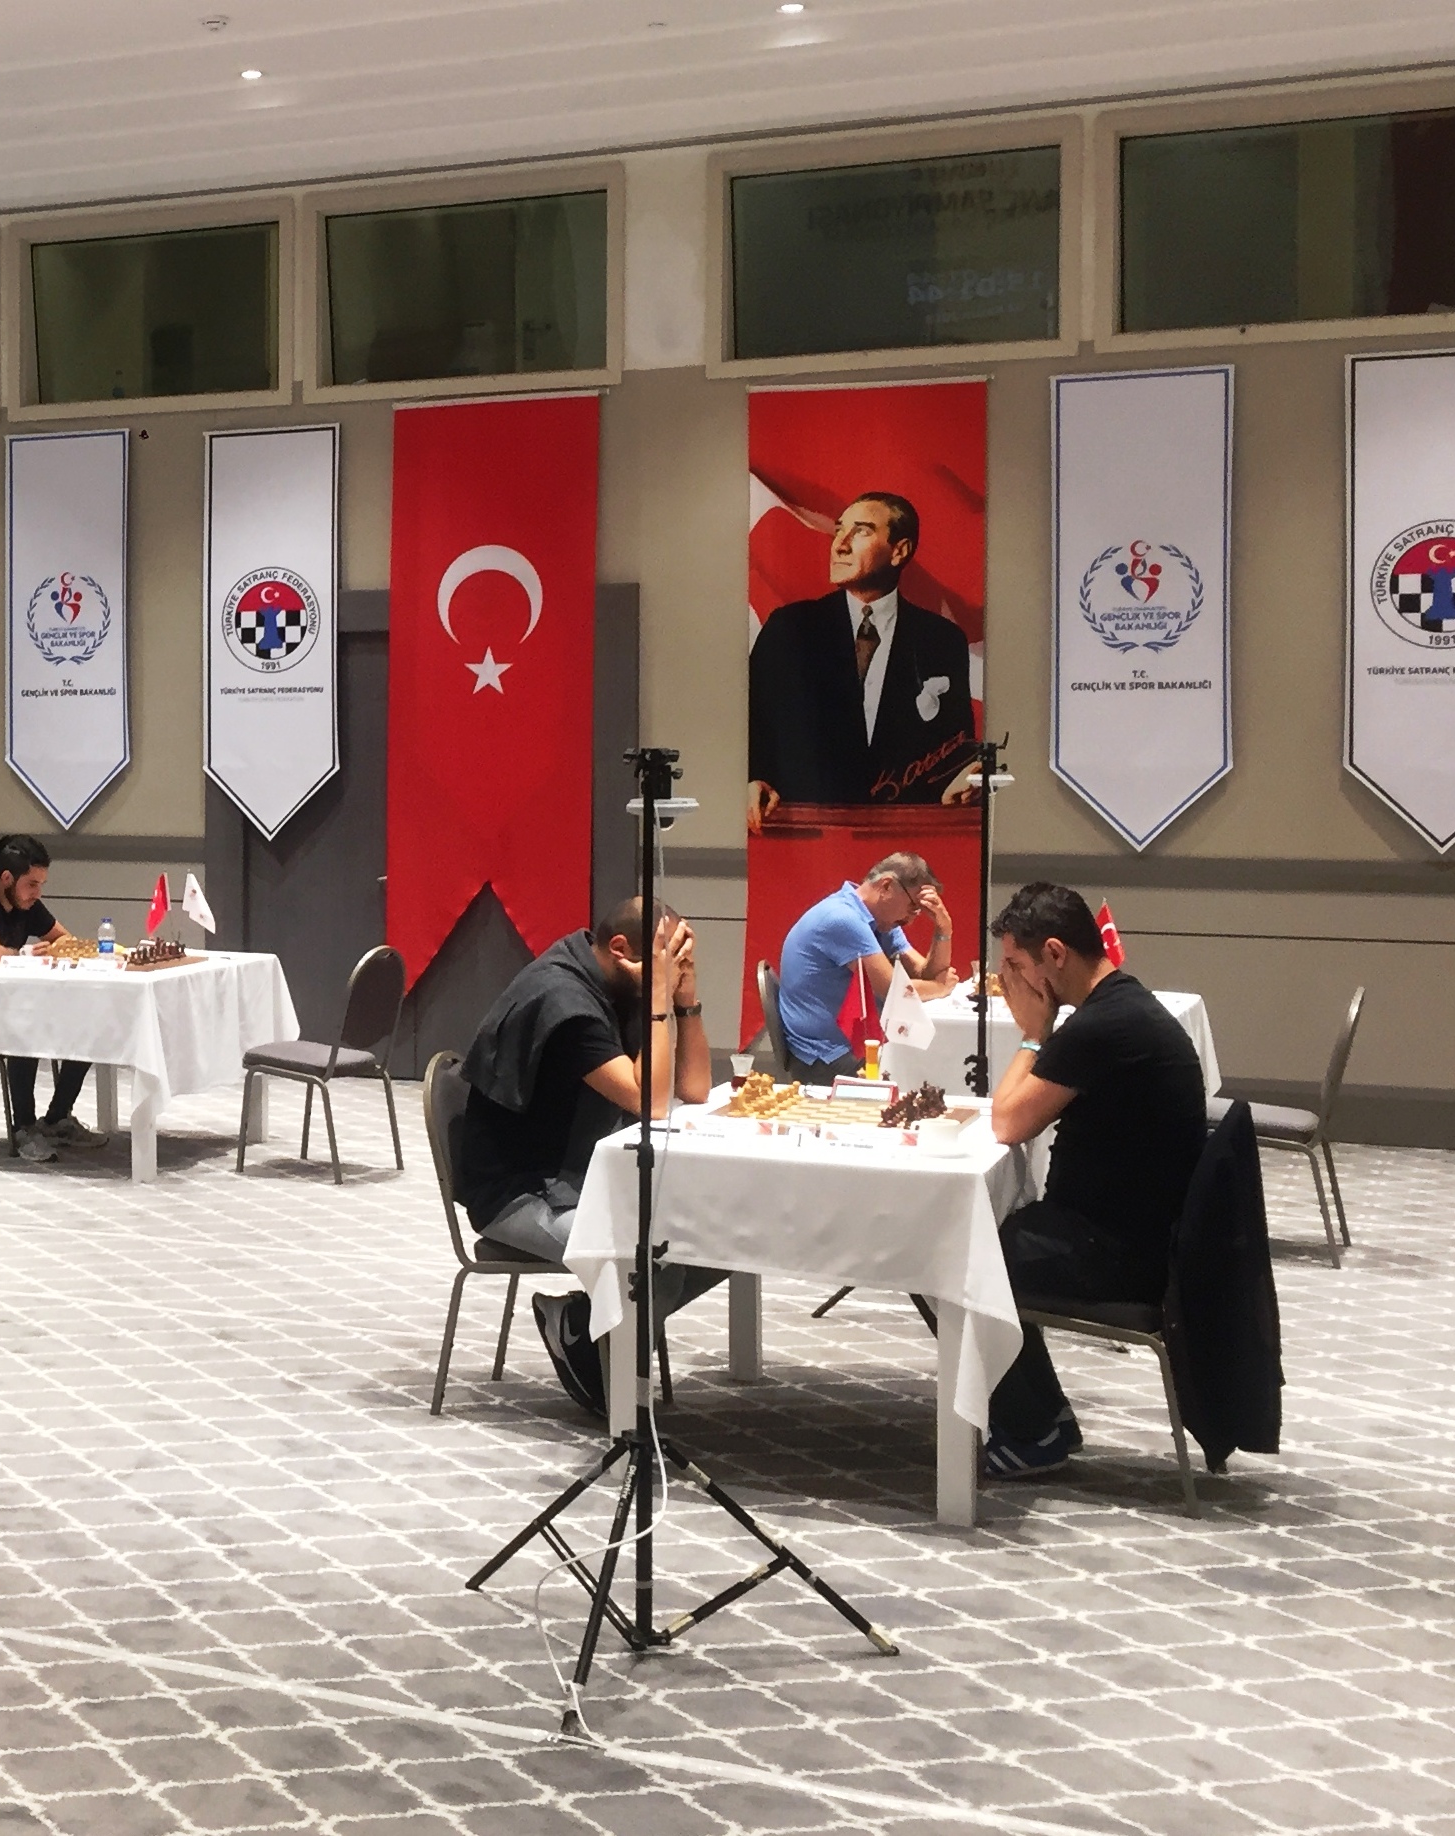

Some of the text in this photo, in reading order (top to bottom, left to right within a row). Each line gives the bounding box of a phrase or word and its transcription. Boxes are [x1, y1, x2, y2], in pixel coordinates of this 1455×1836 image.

[1375, 524, 1455, 605] TÜRKİYE SATRANÇ
[225, 571, 317, 637] TÜRKİYE SATRANÇ FEDERASYONU
[1156, 611, 1181, 620] SPOR
[260, 661, 281, 670] 1991
[1132, 670, 1149, 678] T.C.
[1367, 665, 1451, 677] TÜRKİYE SATRANÇ
[220, 686, 246, 695] TÜRKİYE
[1071, 679, 1212, 693] GENÇLİK VE SPOR BAKANLIĞI
[50, 688, 58, 697] VE
[60, 688, 78, 697] SPOR
